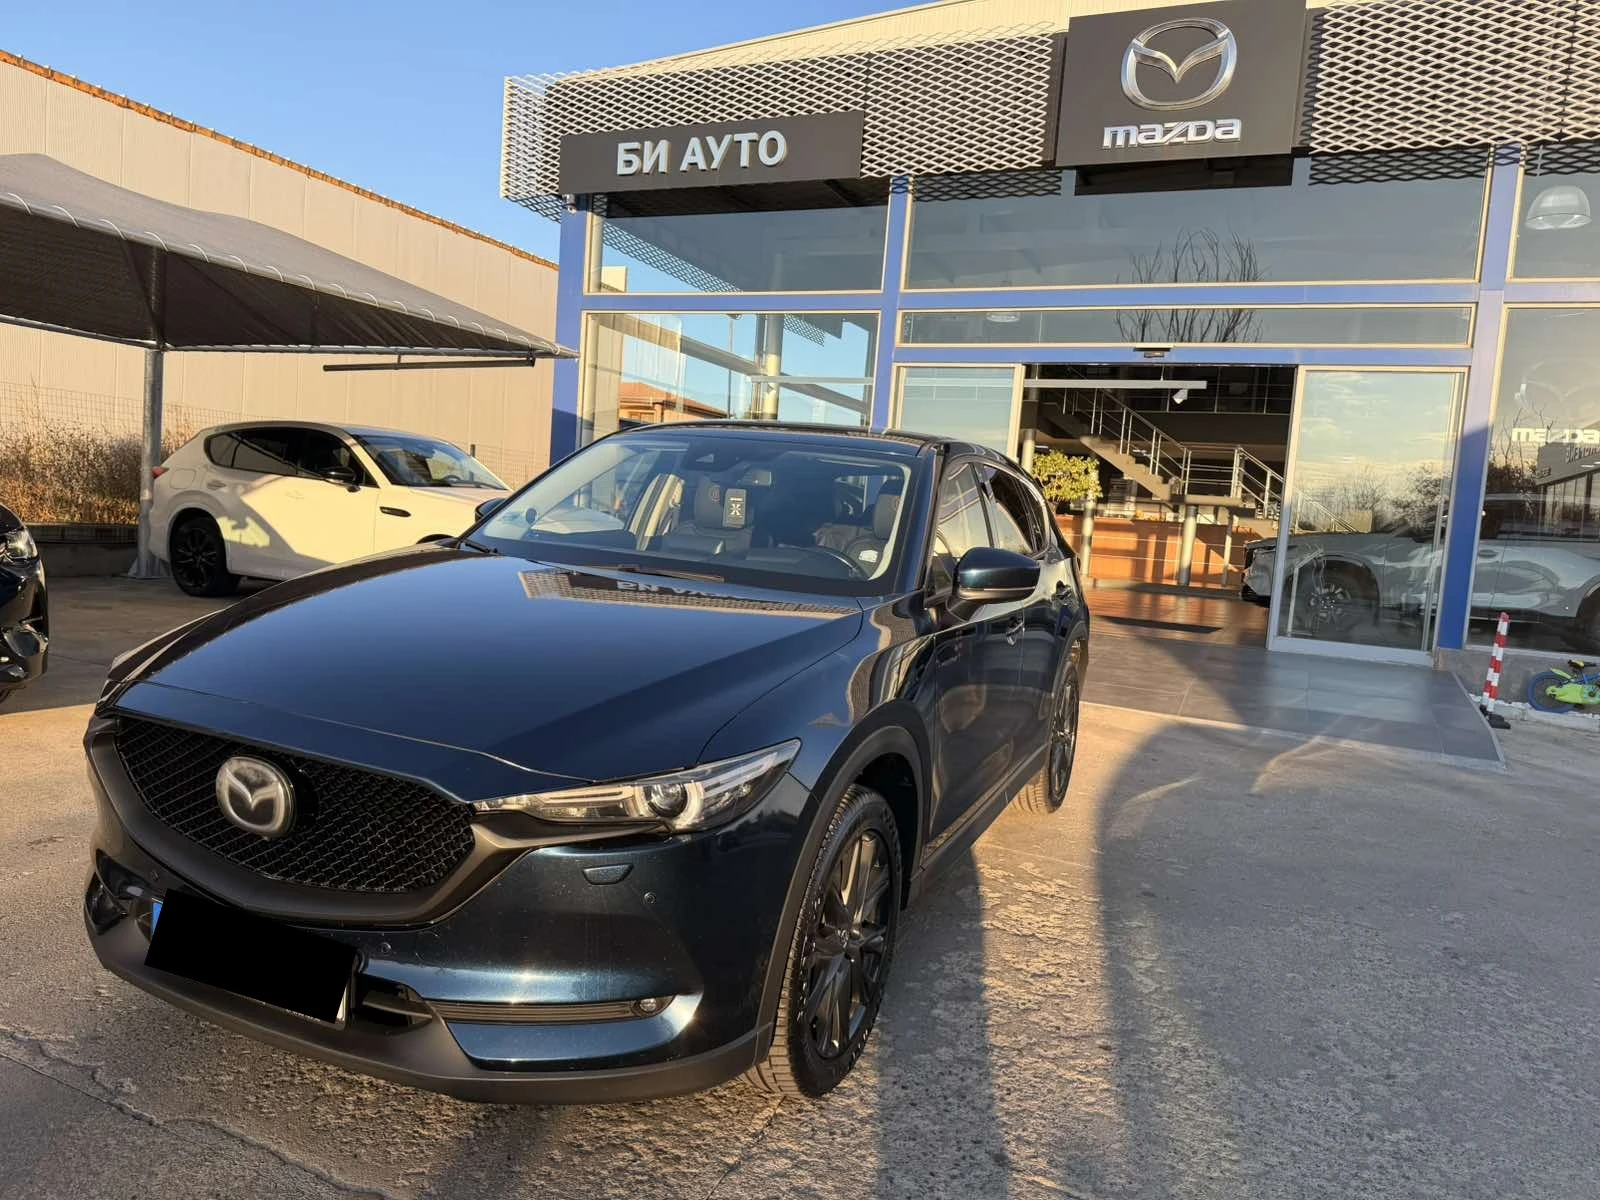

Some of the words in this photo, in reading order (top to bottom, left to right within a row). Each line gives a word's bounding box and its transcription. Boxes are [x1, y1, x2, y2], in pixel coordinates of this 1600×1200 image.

[1102, 118, 1242, 149] mazda
[616, 139, 670, 176] БИ
[679, 130, 788, 172] АУТО
[1511, 427, 1600, 444] mazda
